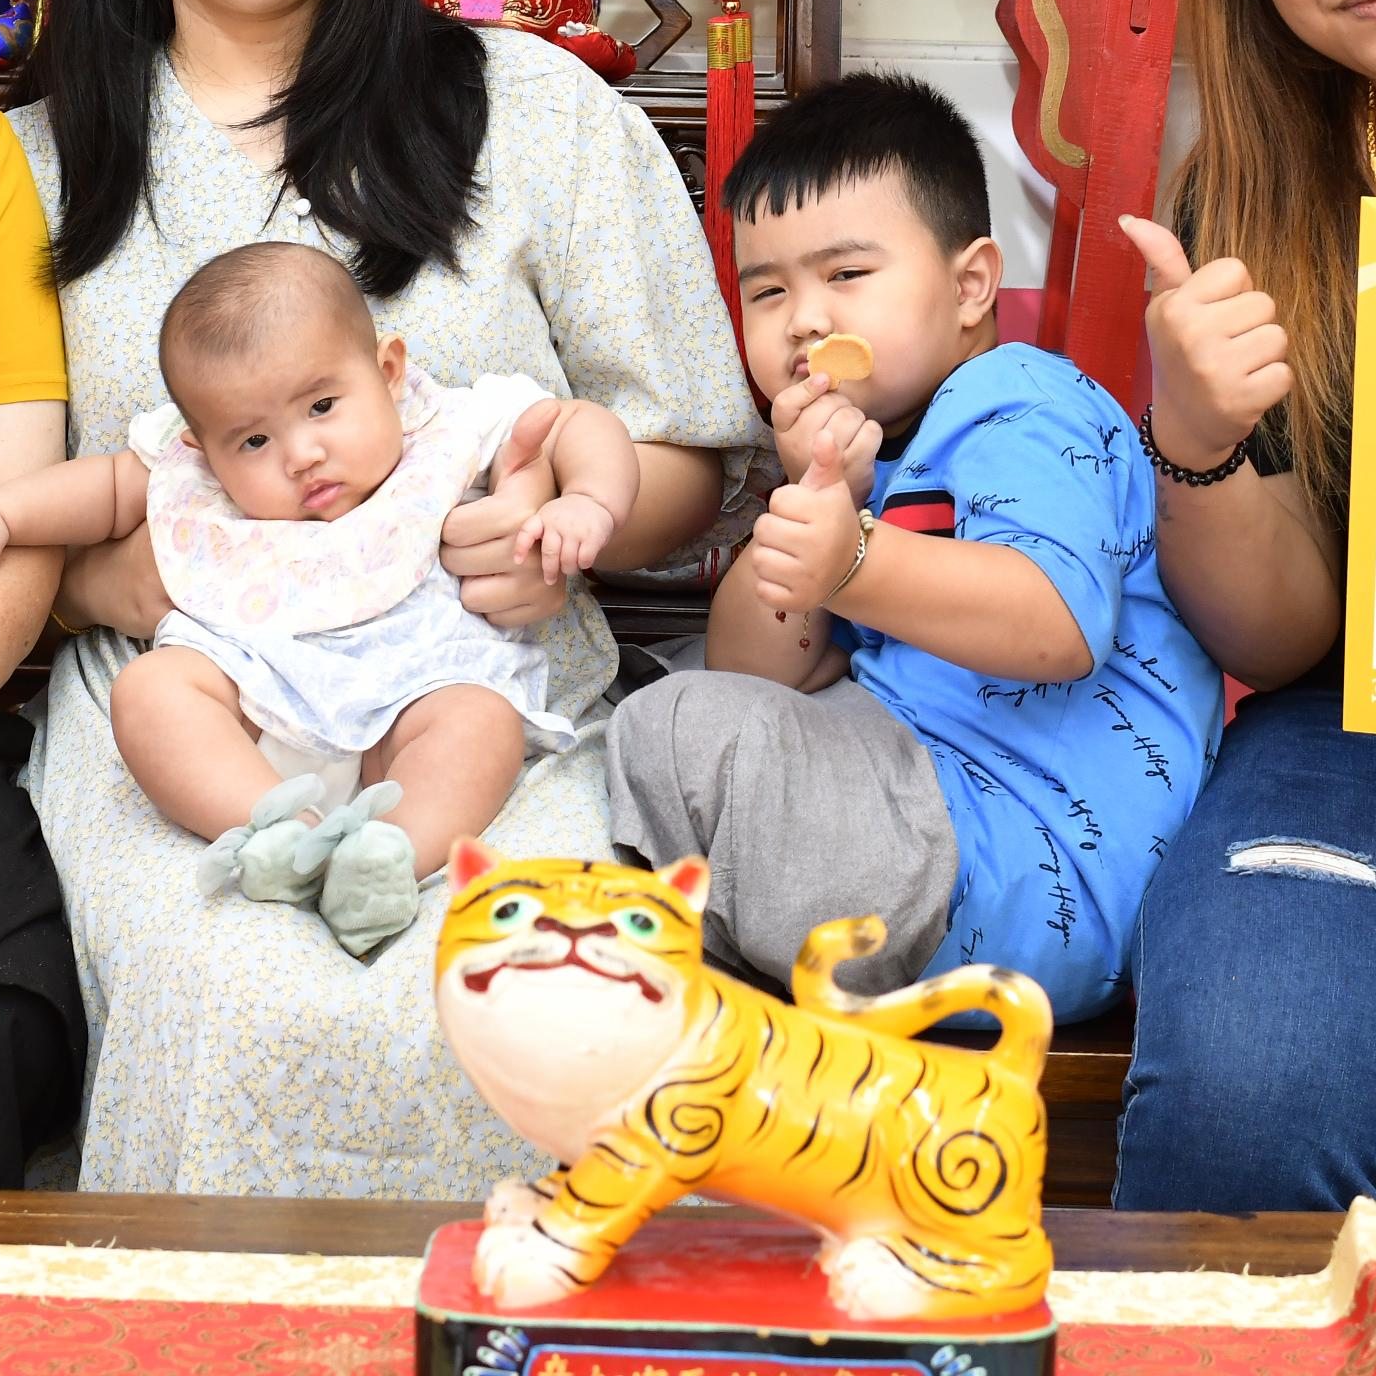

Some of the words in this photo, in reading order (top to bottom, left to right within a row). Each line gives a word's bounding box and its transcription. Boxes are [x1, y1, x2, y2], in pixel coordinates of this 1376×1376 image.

[1093, 683, 1135, 732] Tommy
[1133, 734, 1173, 793] Hilfiger
[1046, 881, 1077, 949] Hilfiger
